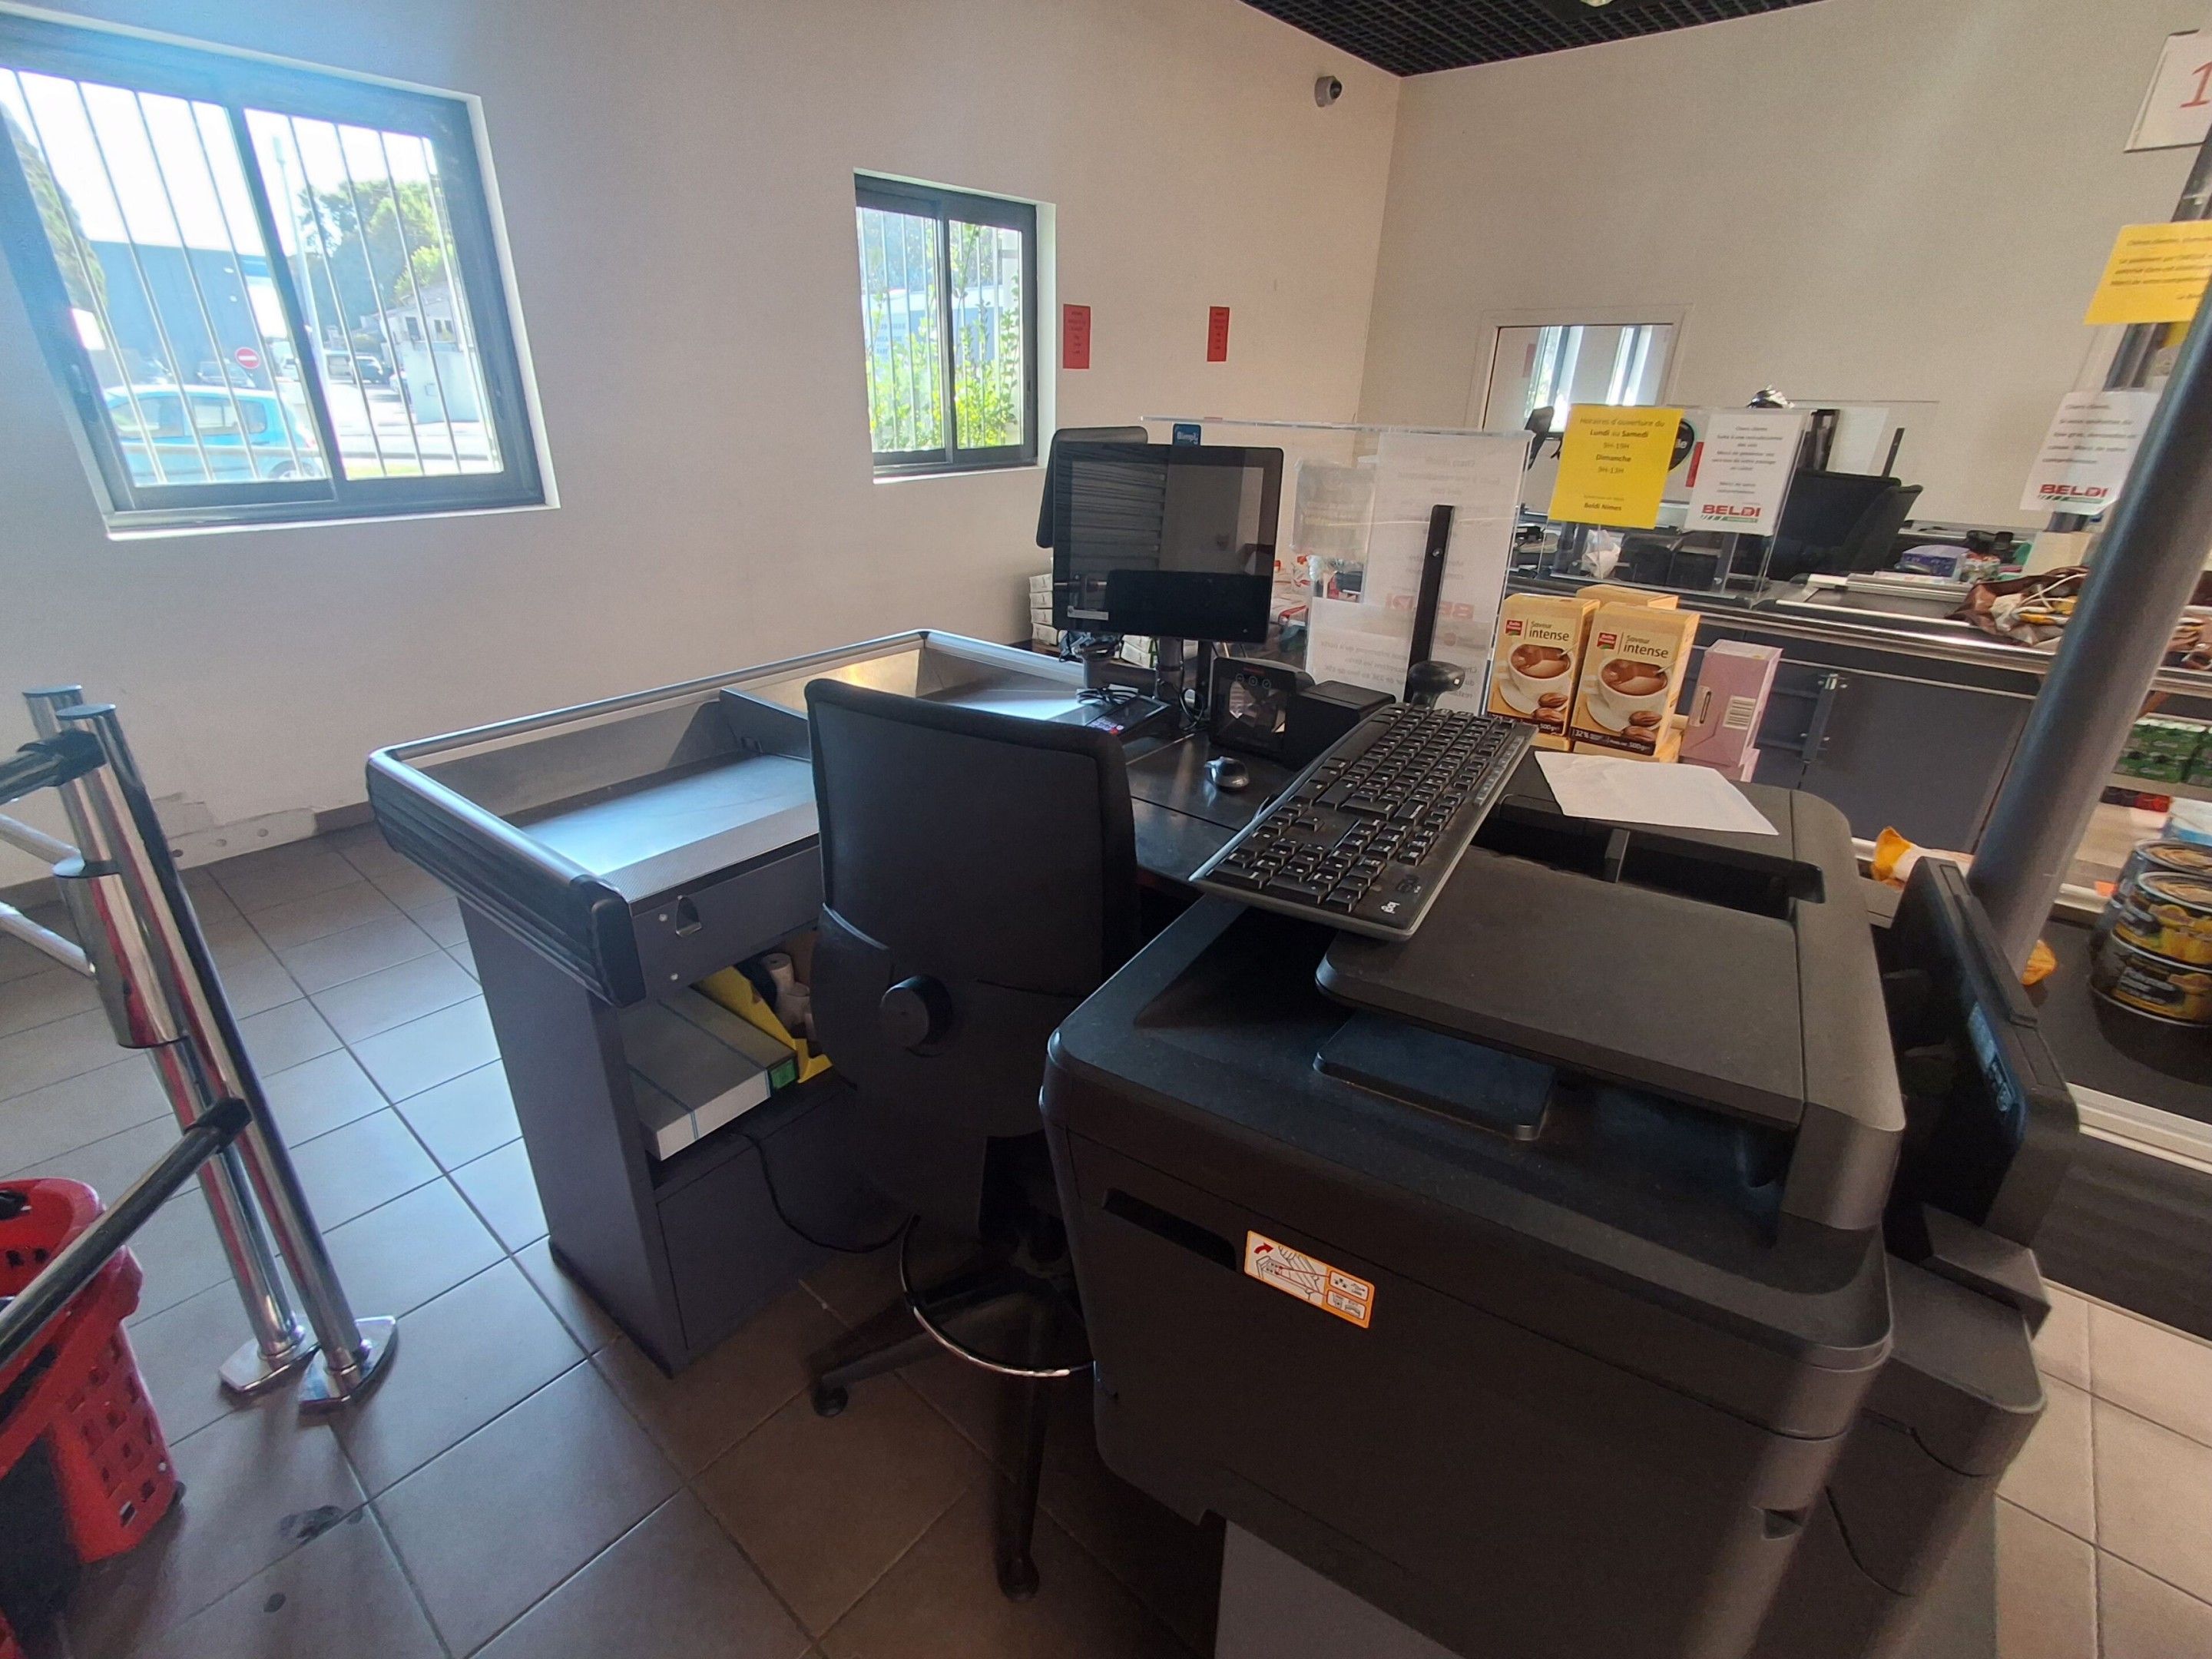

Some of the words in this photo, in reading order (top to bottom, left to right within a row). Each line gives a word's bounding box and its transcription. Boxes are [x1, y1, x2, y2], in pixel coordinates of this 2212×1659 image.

[2180, 61, 2212, 108] 1
[1596, 454, 1632, 462] Dimanche
[2039, 484, 2108, 498] BELDI
[1702, 504, 1762, 517] BELDI
[1529, 628, 1570, 641] intense
[1624, 644, 1669, 658] intense
